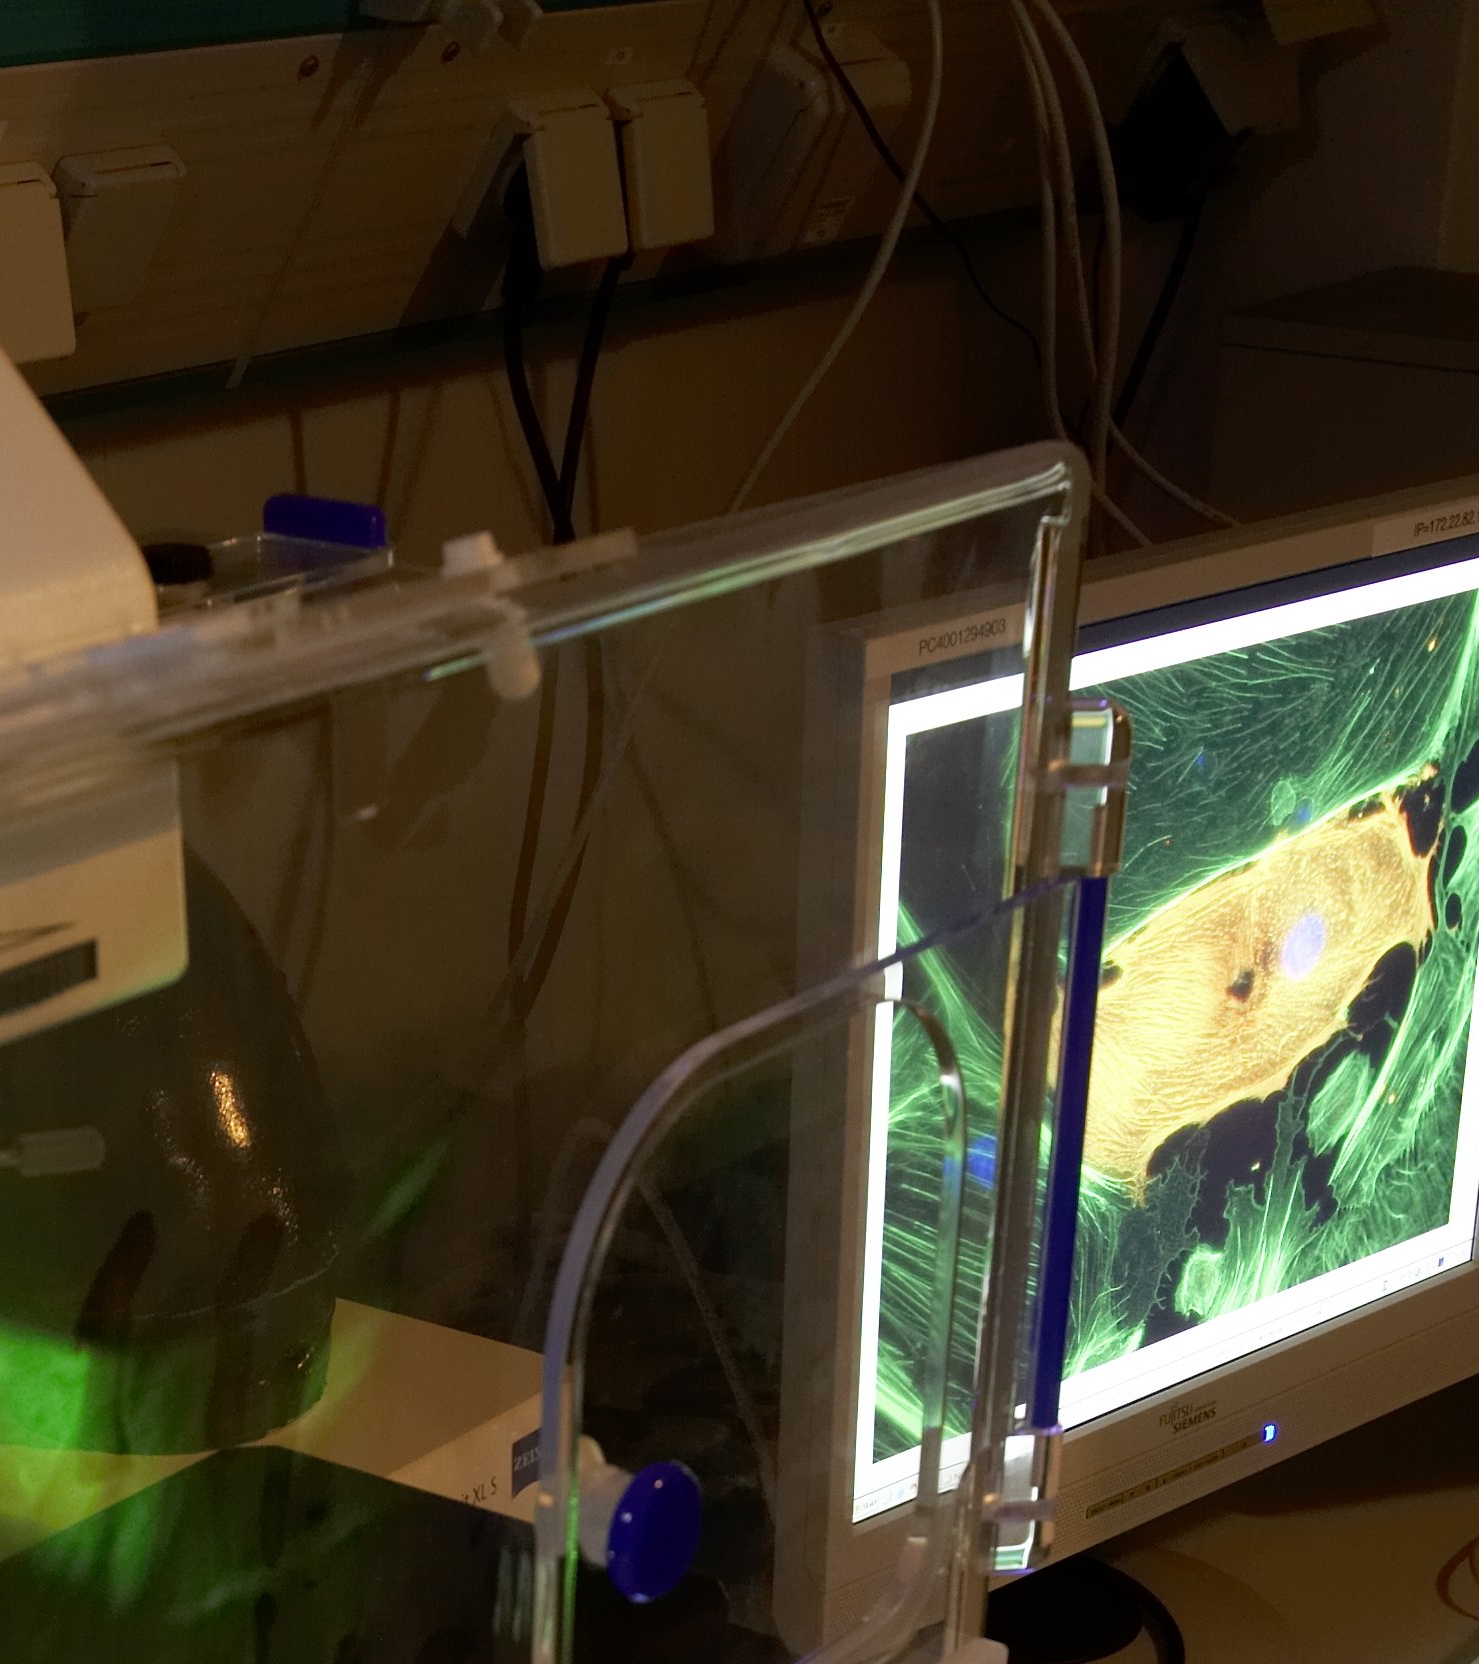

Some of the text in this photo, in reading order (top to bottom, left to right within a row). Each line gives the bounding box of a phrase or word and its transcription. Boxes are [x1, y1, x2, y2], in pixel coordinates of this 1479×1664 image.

[918, 618, 1007, 656] PC4001294903
[1173, 1406, 1217, 1434] SIEMENS
[514, 1447, 541, 1471] ZEIS
